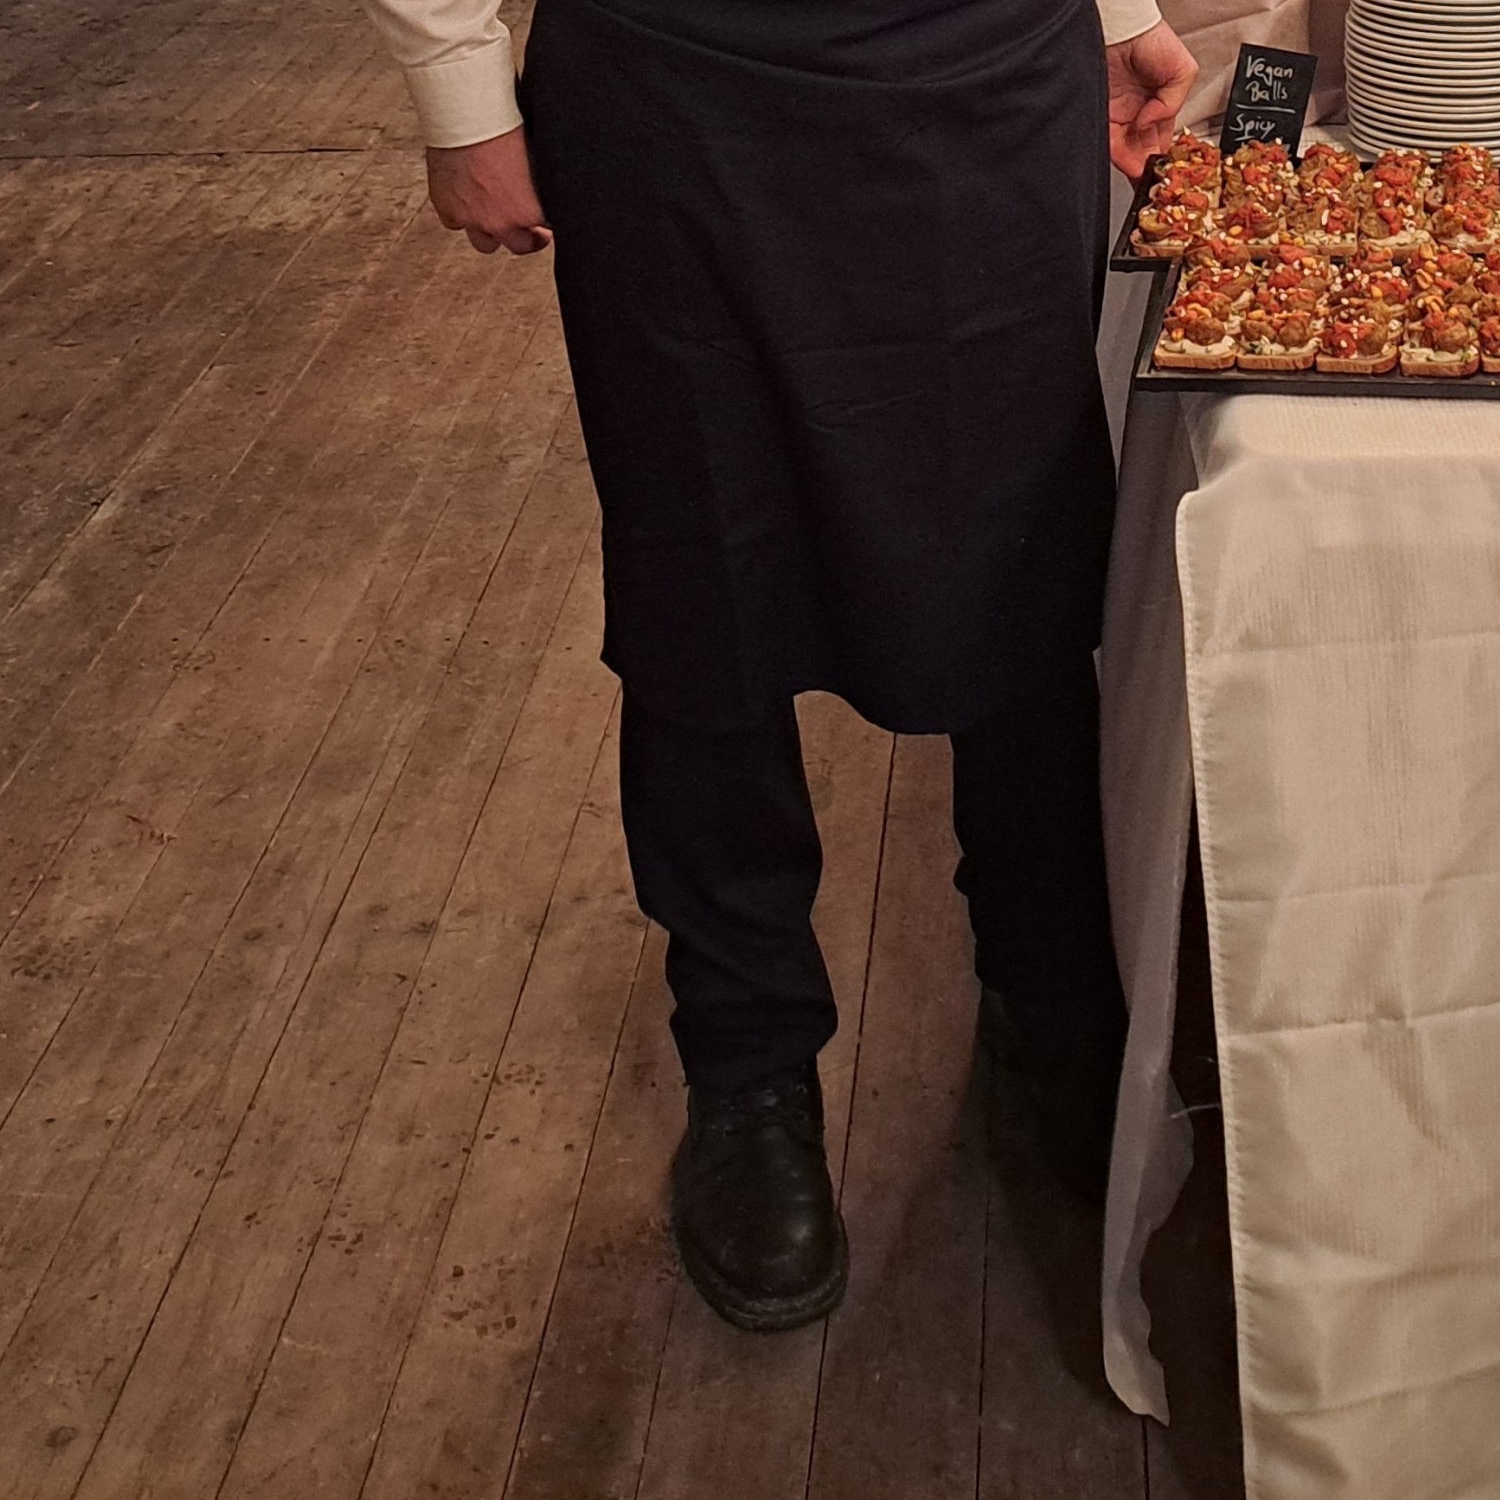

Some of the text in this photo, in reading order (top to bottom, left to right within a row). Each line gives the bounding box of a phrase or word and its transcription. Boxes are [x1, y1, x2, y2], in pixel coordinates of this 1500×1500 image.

[1245, 55, 1293, 87] Vegan
[1245, 81, 1288, 102] Balls
[1229, 113, 1276, 140] Spicy
